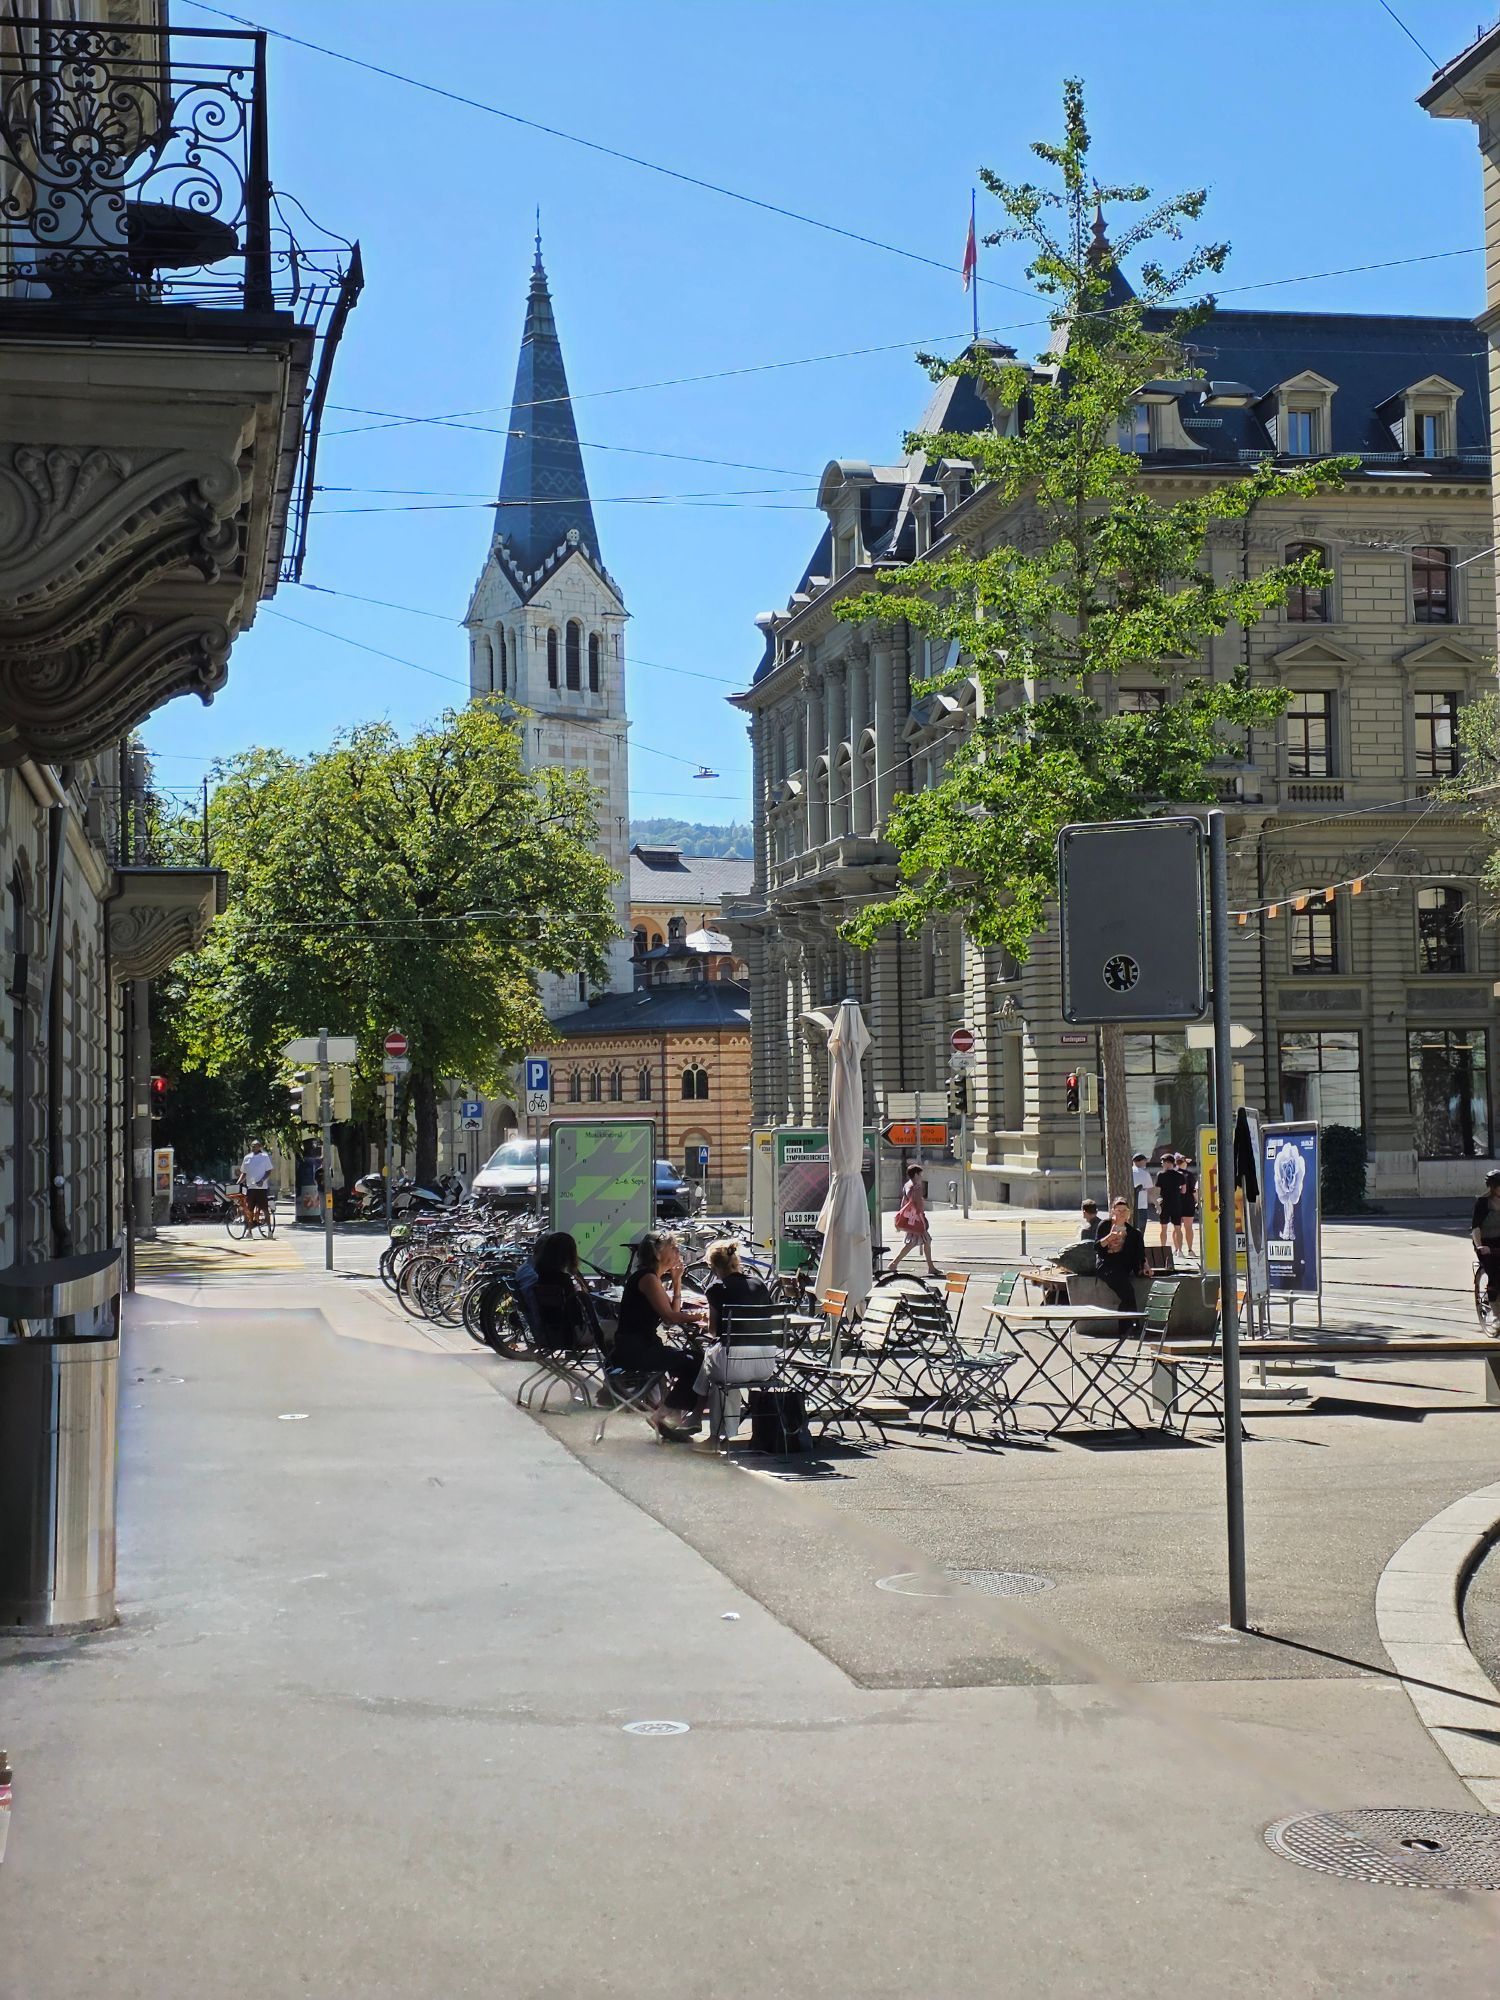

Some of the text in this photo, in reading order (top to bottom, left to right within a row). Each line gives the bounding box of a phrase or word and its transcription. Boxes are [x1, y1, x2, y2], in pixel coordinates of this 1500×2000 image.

[531, 1063, 544, 1088] P
[467, 1103, 478, 1117] P
[788, 1214, 802, 1223] ALSO
